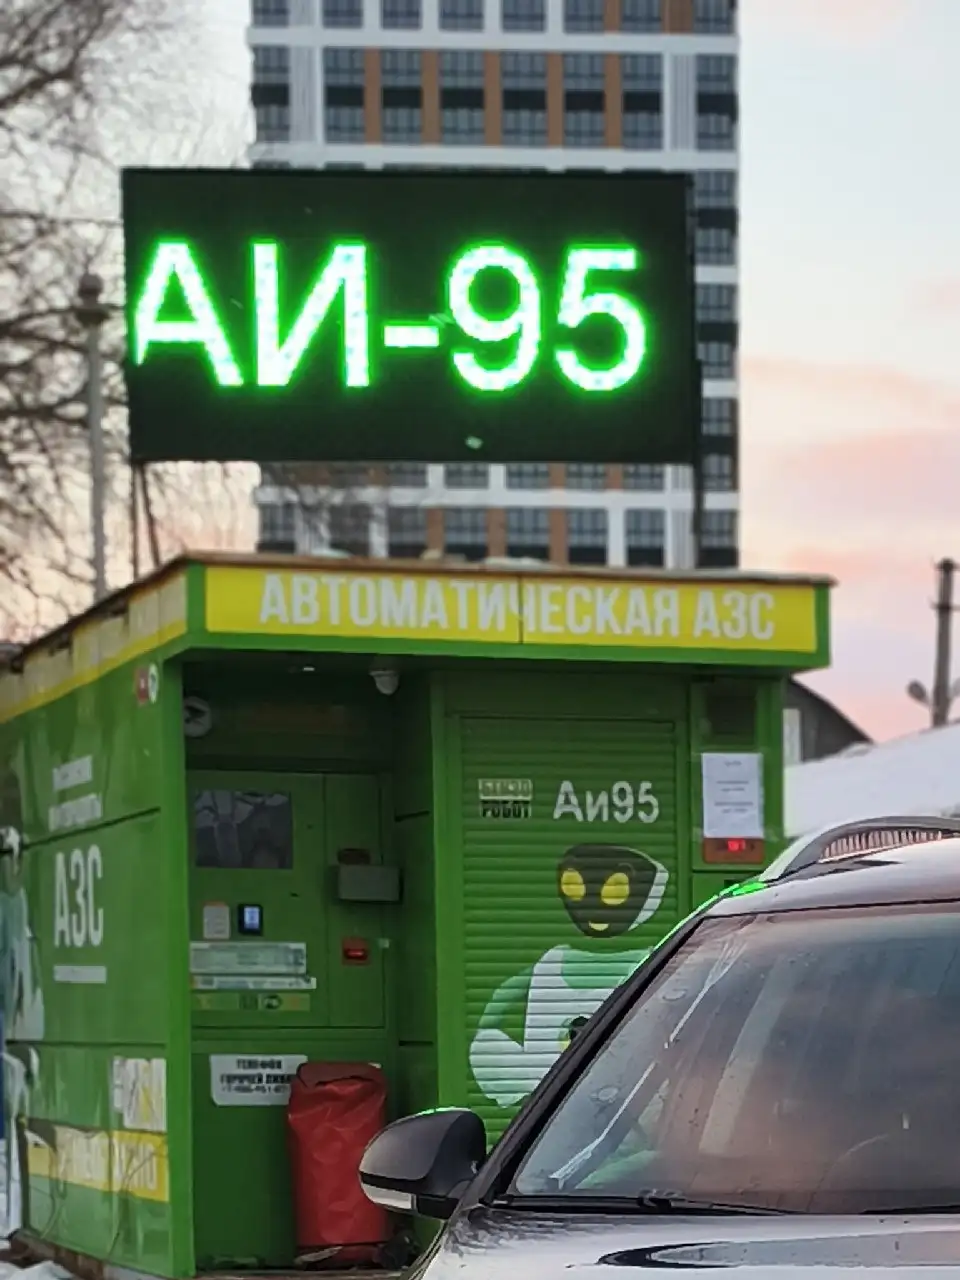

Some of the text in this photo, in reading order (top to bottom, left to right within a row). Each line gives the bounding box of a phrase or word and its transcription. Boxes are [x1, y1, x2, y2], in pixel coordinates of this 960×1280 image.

[134, 243, 646, 391] АИ-95
[259, 573, 775, 641] АВТОМАТИЧЕСКАЯ АЗС
[552, 780, 660, 823] Аи95
[54, 845, 104, 948] АЗС
